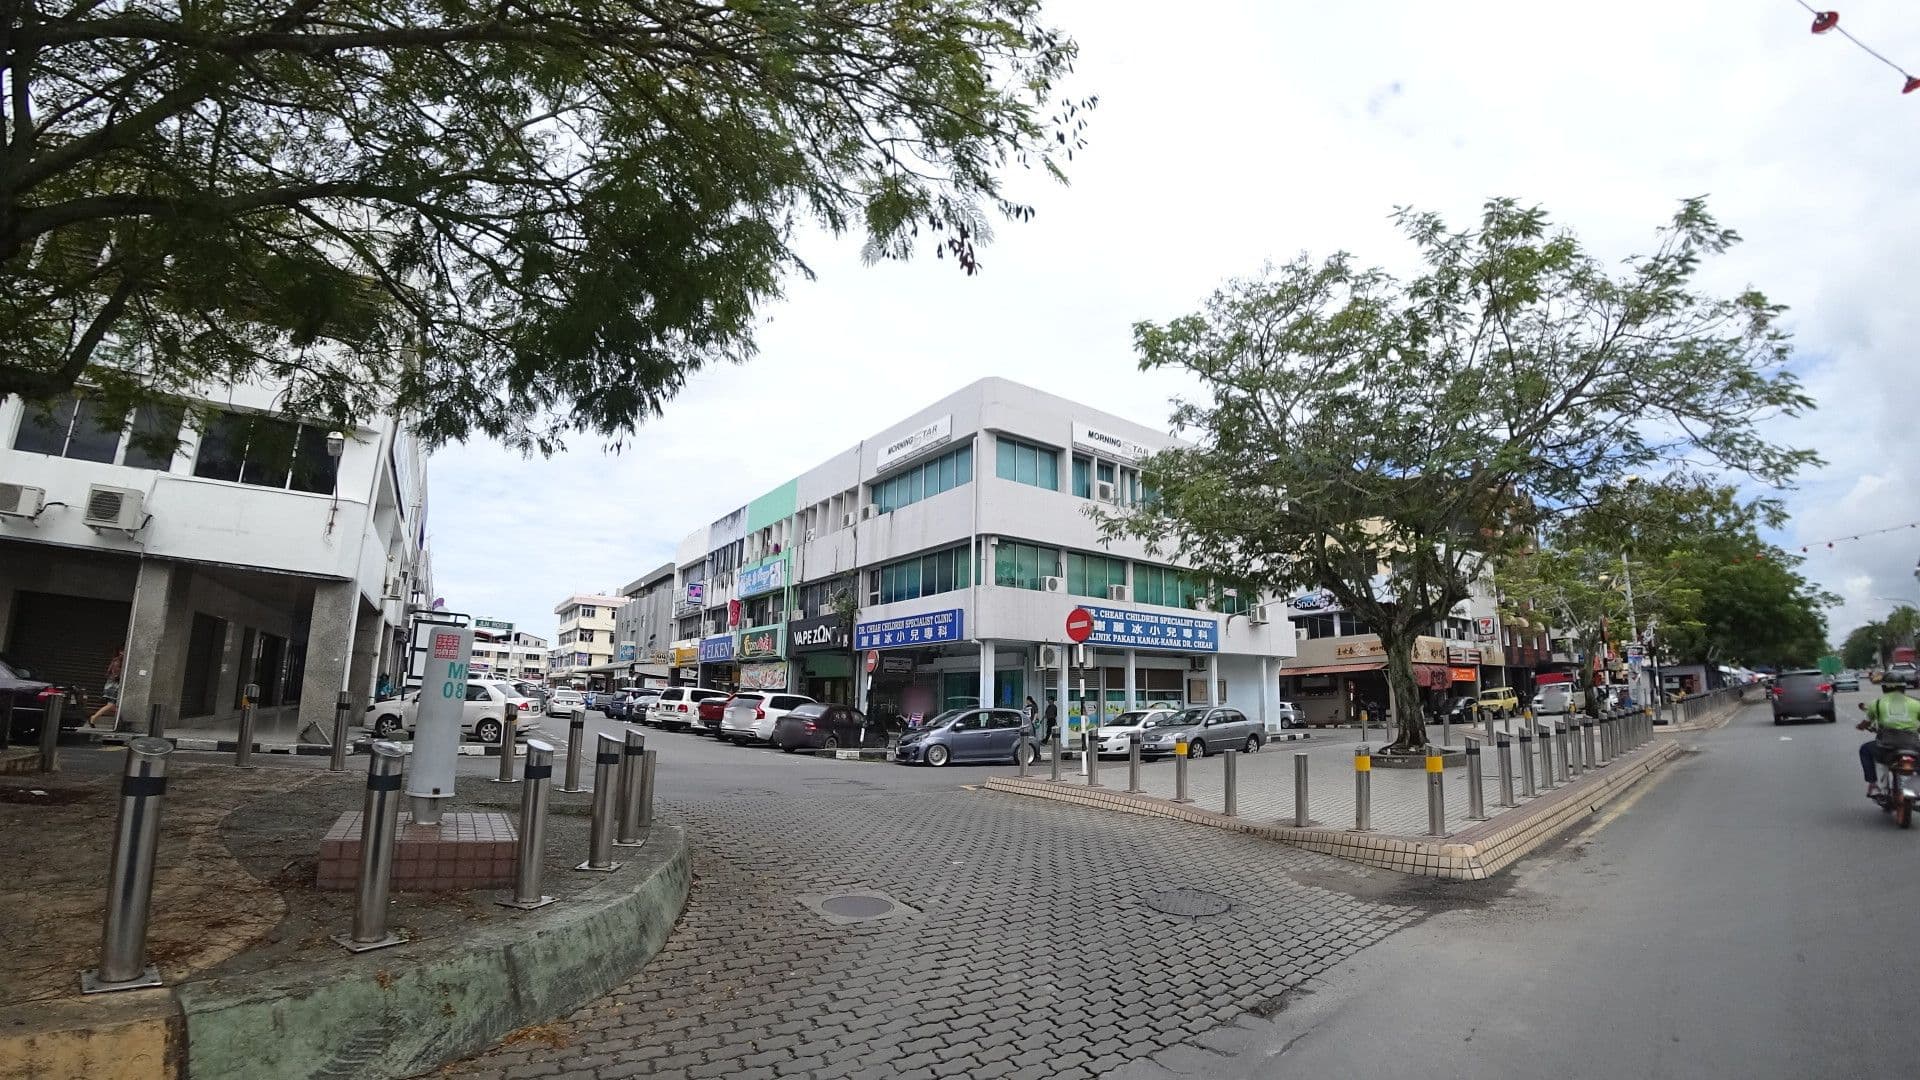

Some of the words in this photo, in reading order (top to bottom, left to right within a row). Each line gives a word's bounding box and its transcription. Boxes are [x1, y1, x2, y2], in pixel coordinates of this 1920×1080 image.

[887, 436, 914, 455] MORNING
[1087, 430, 1122, 448] MORNING
[882, 620, 905, 632] CHILDREN
[905, 615, 934, 629] SPECIALIST
[934, 612, 953, 624] CLINIC
[1099, 610, 1124, 620] CHEAH
[1125, 613, 1159, 625] CHILDREN
[1160, 616, 1194, 628] SPECIALIST
[1194, 620, 1213, 629] CLINIC
[793, 630, 812, 646] VAPE
[1112, 634, 1136, 644] PAKAR
[1137, 635, 1181, 647] KANAK-KANAK
[1182, 640, 1193, 648] DR.
[1193, 641, 1213, 650] CHEAH
[706, 641, 731, 659] ELKEN
[443, 681, 464, 699] 08
